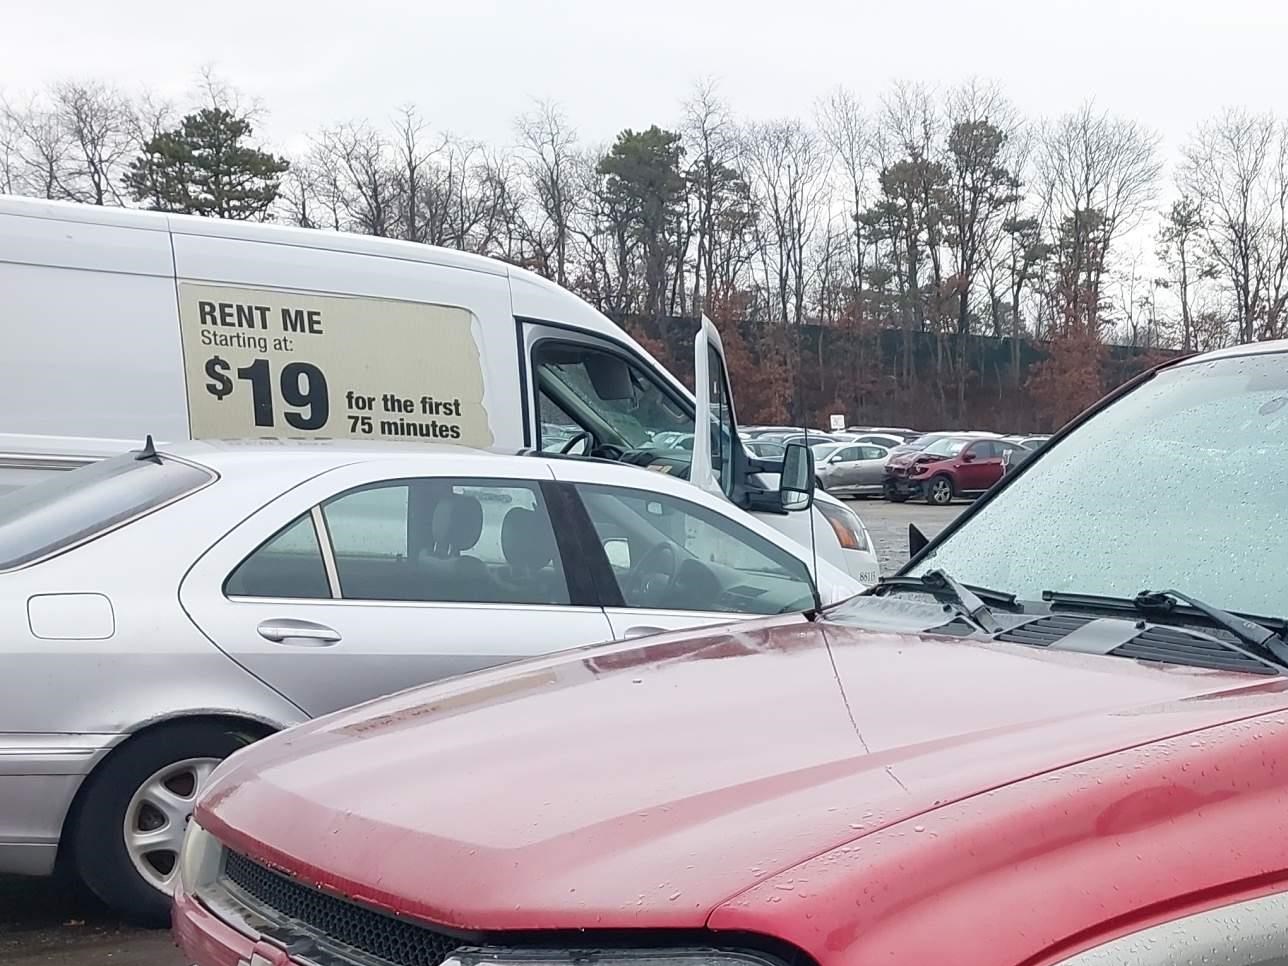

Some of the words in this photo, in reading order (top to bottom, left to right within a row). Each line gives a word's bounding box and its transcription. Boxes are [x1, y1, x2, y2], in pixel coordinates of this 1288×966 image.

[199, 301, 271, 330] RENT
[281, 309, 323, 334] ME
[201, 330, 268, 352] Starting
[273, 336, 294, 352] at:
[205, 356, 329, 431] $19
[346, 391, 375, 412] for
[382, 394, 414, 413] the
[420, 397, 462, 417] first
[348, 416, 373, 434] 75
[380, 418, 461, 439] minutes
